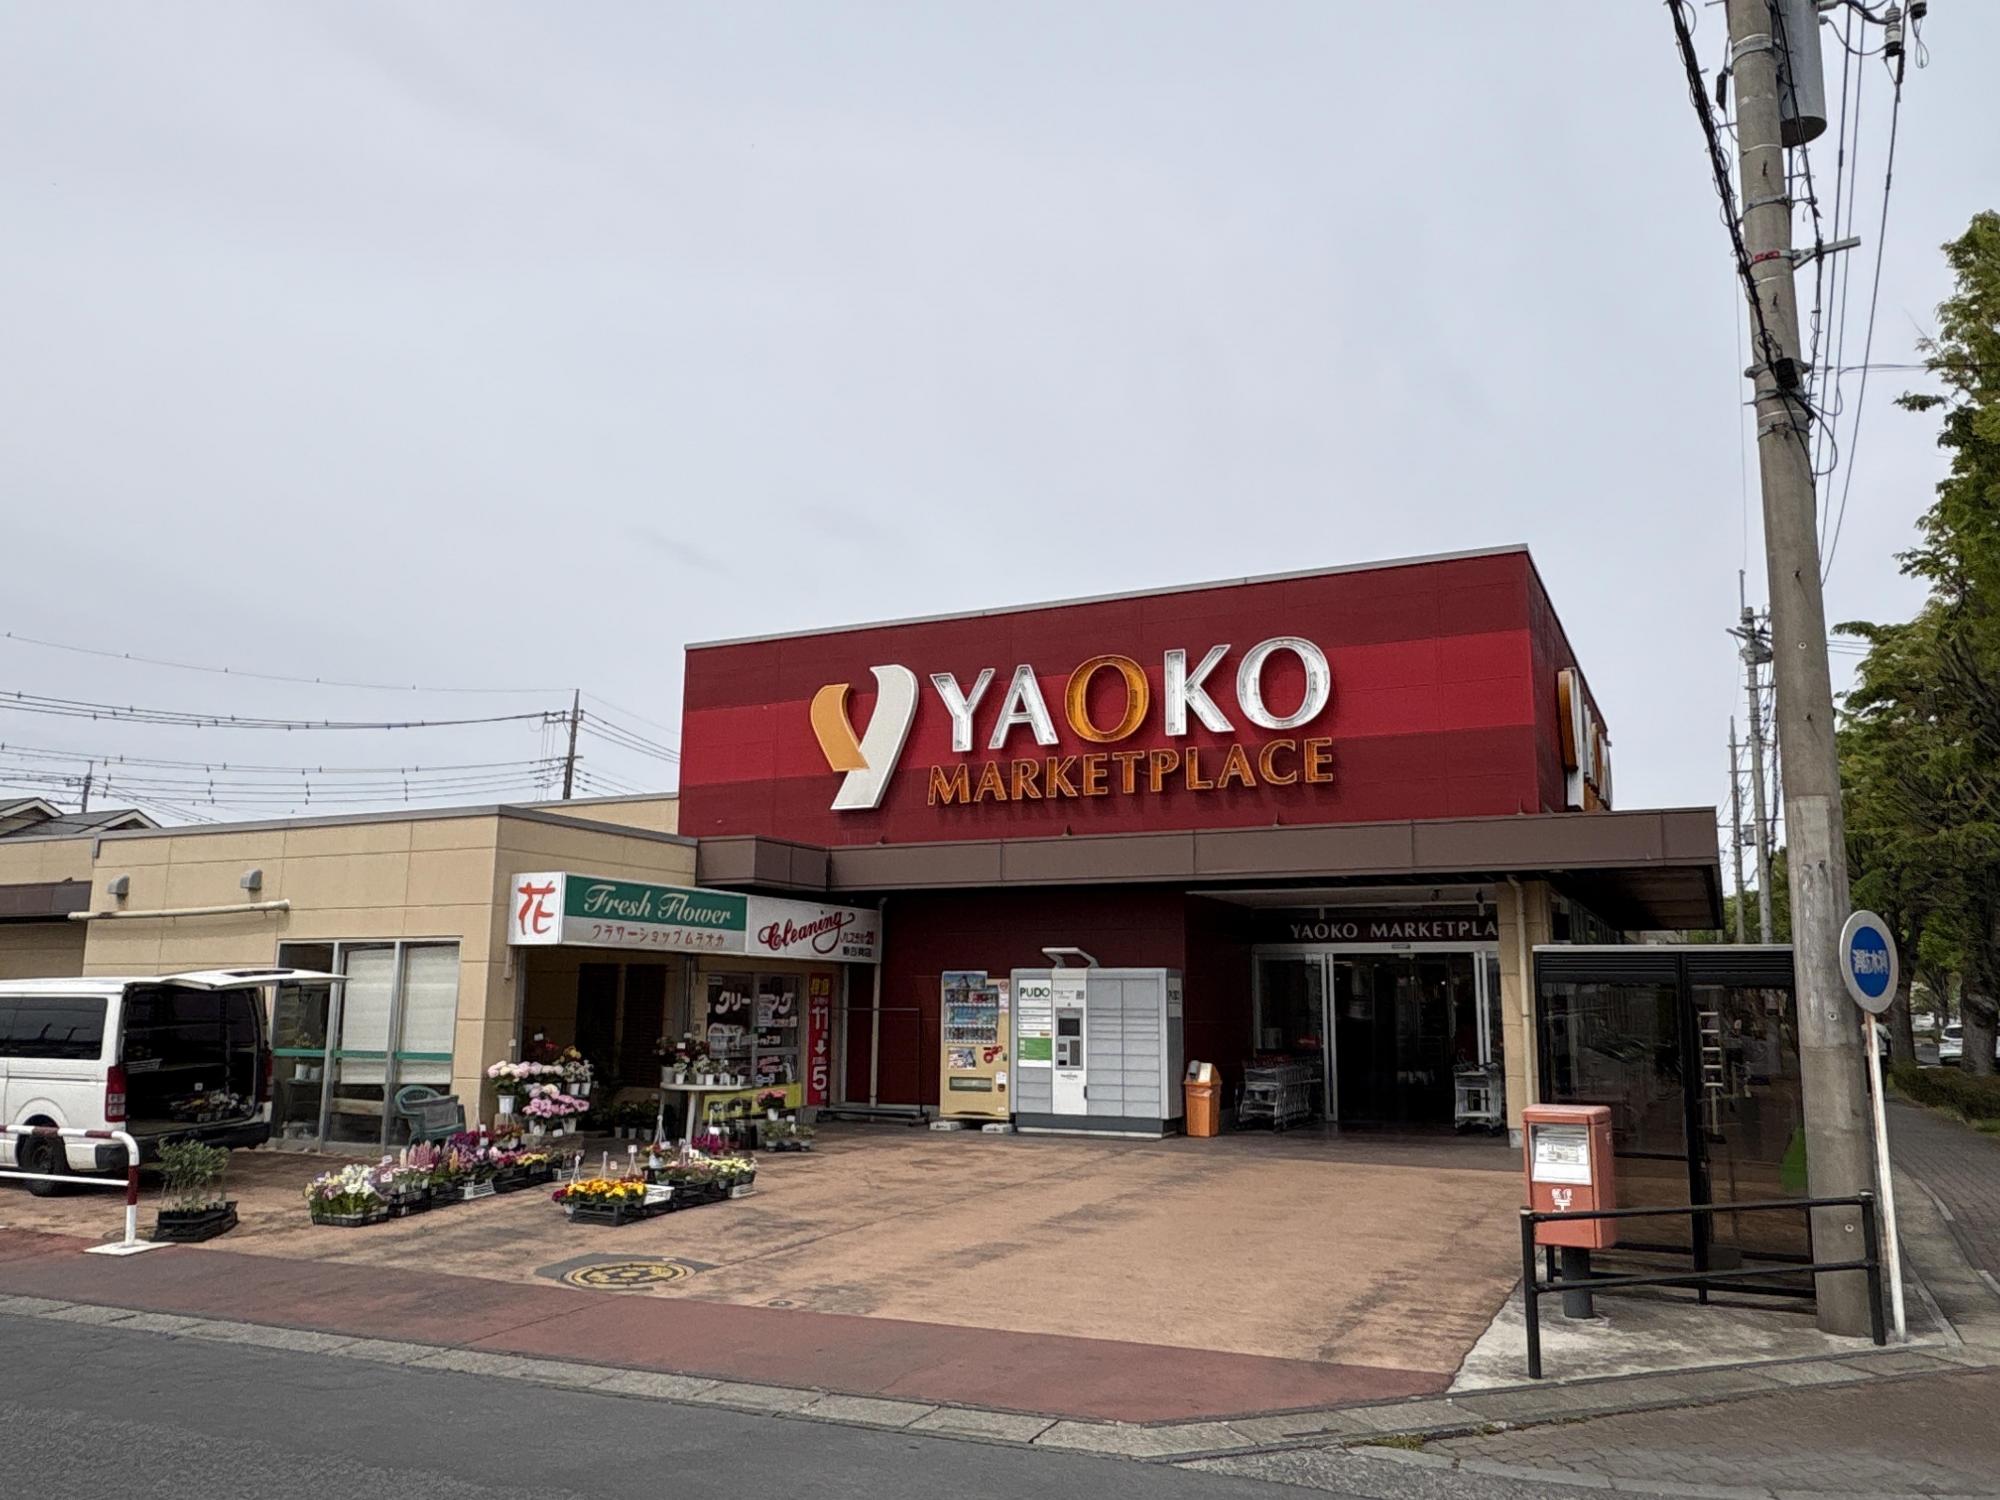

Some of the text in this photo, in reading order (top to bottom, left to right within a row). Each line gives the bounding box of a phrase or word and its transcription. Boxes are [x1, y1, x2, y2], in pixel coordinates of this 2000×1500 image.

[929, 635, 1332, 752] YAOKO
[927, 737, 1334, 807] MARKETPLACE
[518, 880, 555, 935] 花
[584, 885, 732, 925] Fresh Flower
[758, 910, 856, 953] Cleaning
[1290, 922, 1358, 939] YAOKO
[1020, 987, 1050, 998] PUDO
